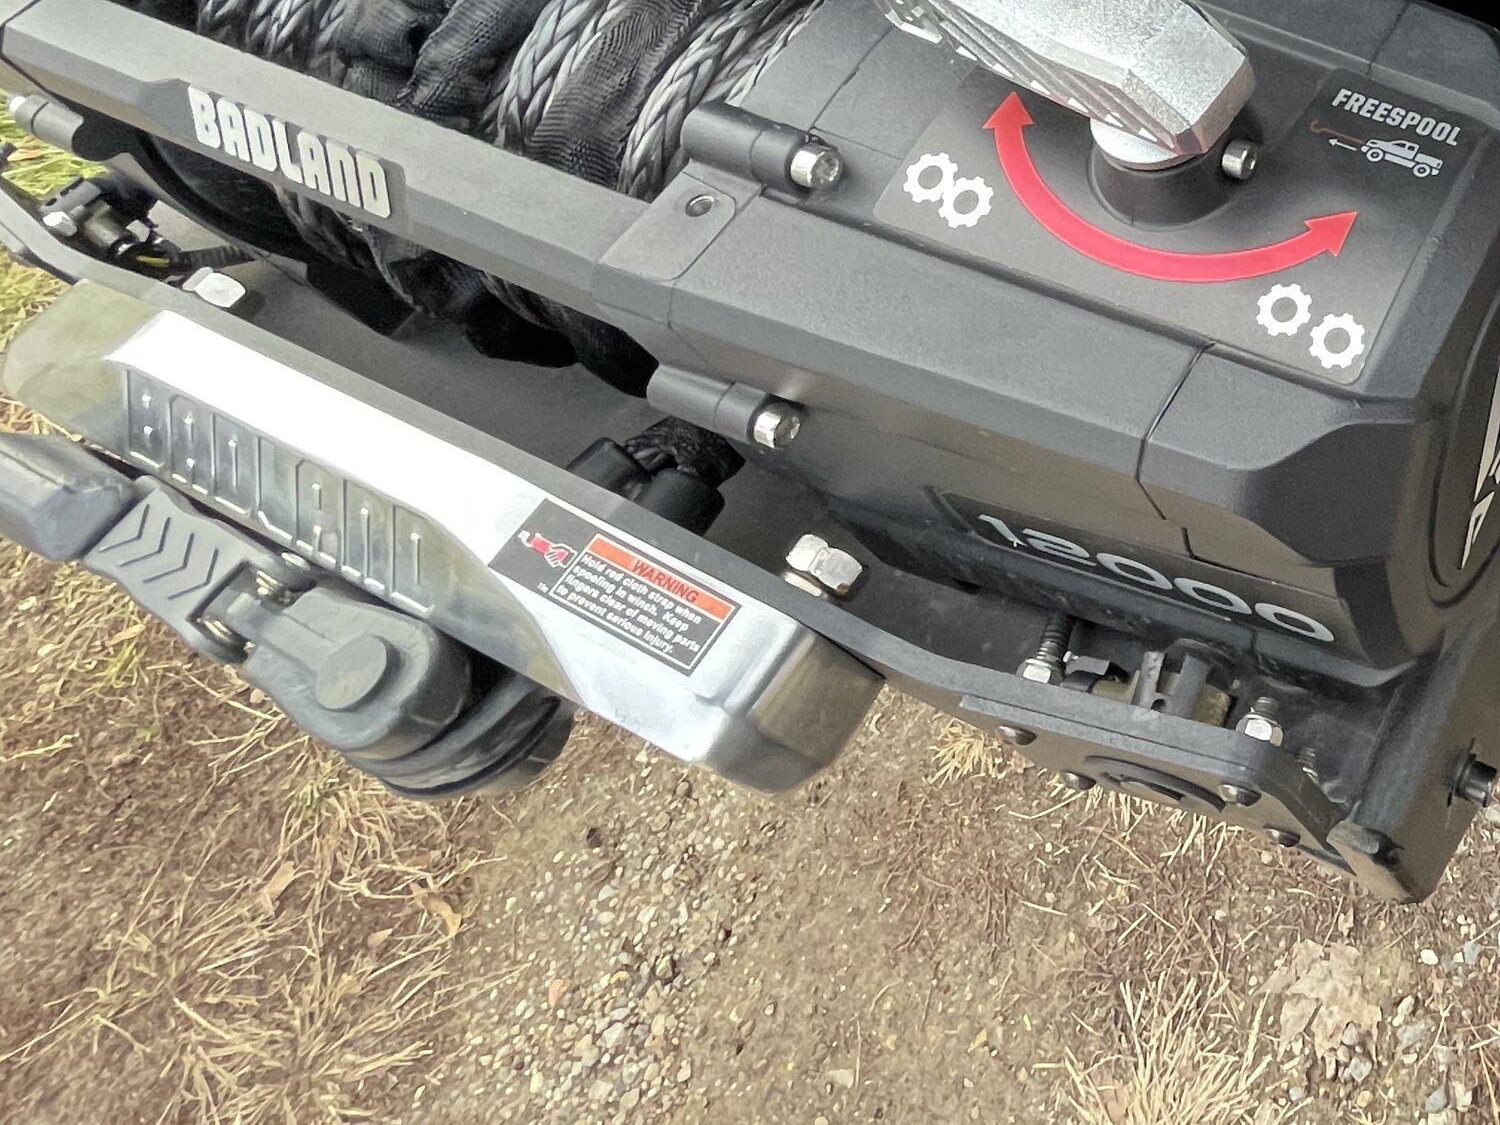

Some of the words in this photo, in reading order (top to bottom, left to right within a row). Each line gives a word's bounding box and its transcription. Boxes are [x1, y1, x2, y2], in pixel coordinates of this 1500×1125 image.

[188, 83, 391, 219] BADLAND
[1331, 88, 1461, 146] FREESPOOL
[555, 584, 569, 596] to
[566, 592, 608, 616] prevent
[605, 611, 644, 636] serious
[573, 565, 616, 594] spooling
[615, 586, 628, 599] in
[662, 611, 690, 632] Keep
[580, 554, 607, 573] Hold
[604, 568, 625, 582] red
[622, 577, 649, 595] cloth
[648, 591, 675, 610] strap
[674, 605, 702, 625] when
[632, 559, 699, 603] WARNING
[978, 513, 1334, 642] 12000
[564, 574, 600, 599] fingers
[599, 594, 627, 612] clear
[625, 608, 640, 618] of
[636, 614, 675, 640] moving
[671, 634, 701, 653] parts
